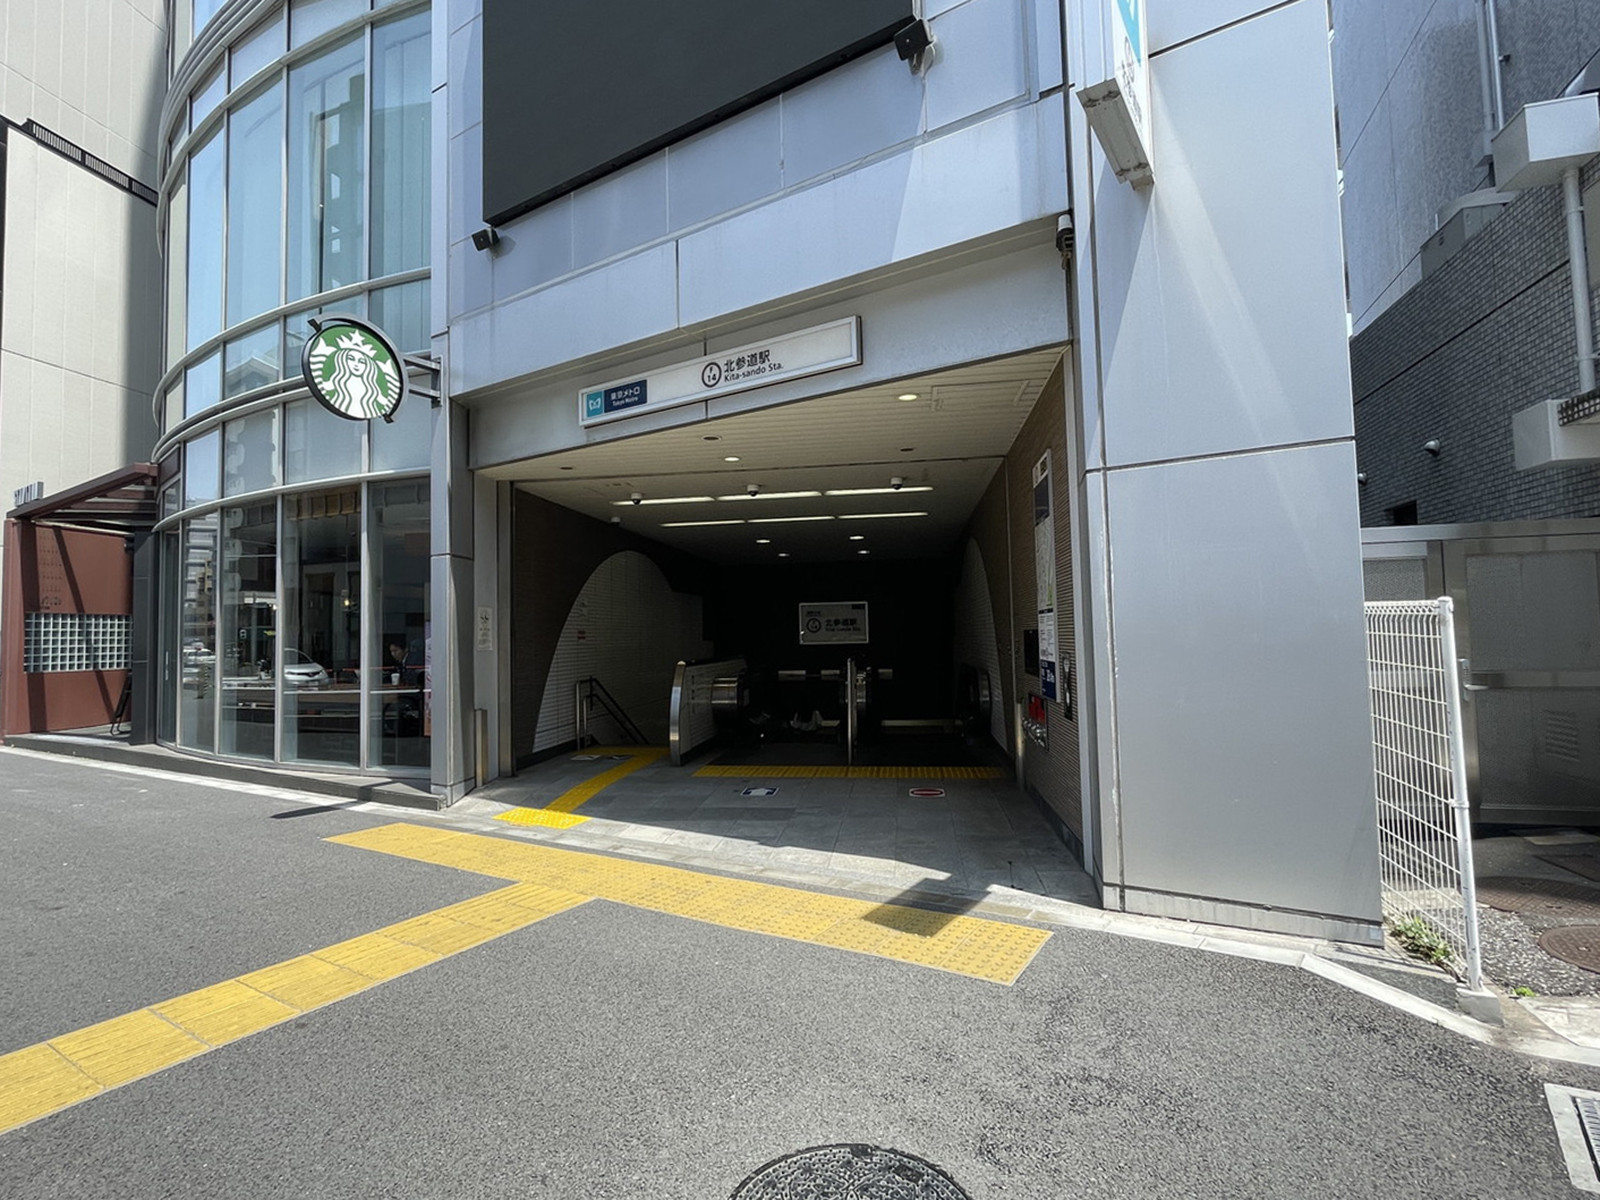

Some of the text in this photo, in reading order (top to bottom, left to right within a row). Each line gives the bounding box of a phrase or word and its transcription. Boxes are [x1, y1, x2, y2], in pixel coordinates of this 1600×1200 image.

[723, 349, 771, 373] 北参道駅
[707, 373, 717, 382] 14
[724, 362, 784, 383] Kita-sando Sta.
